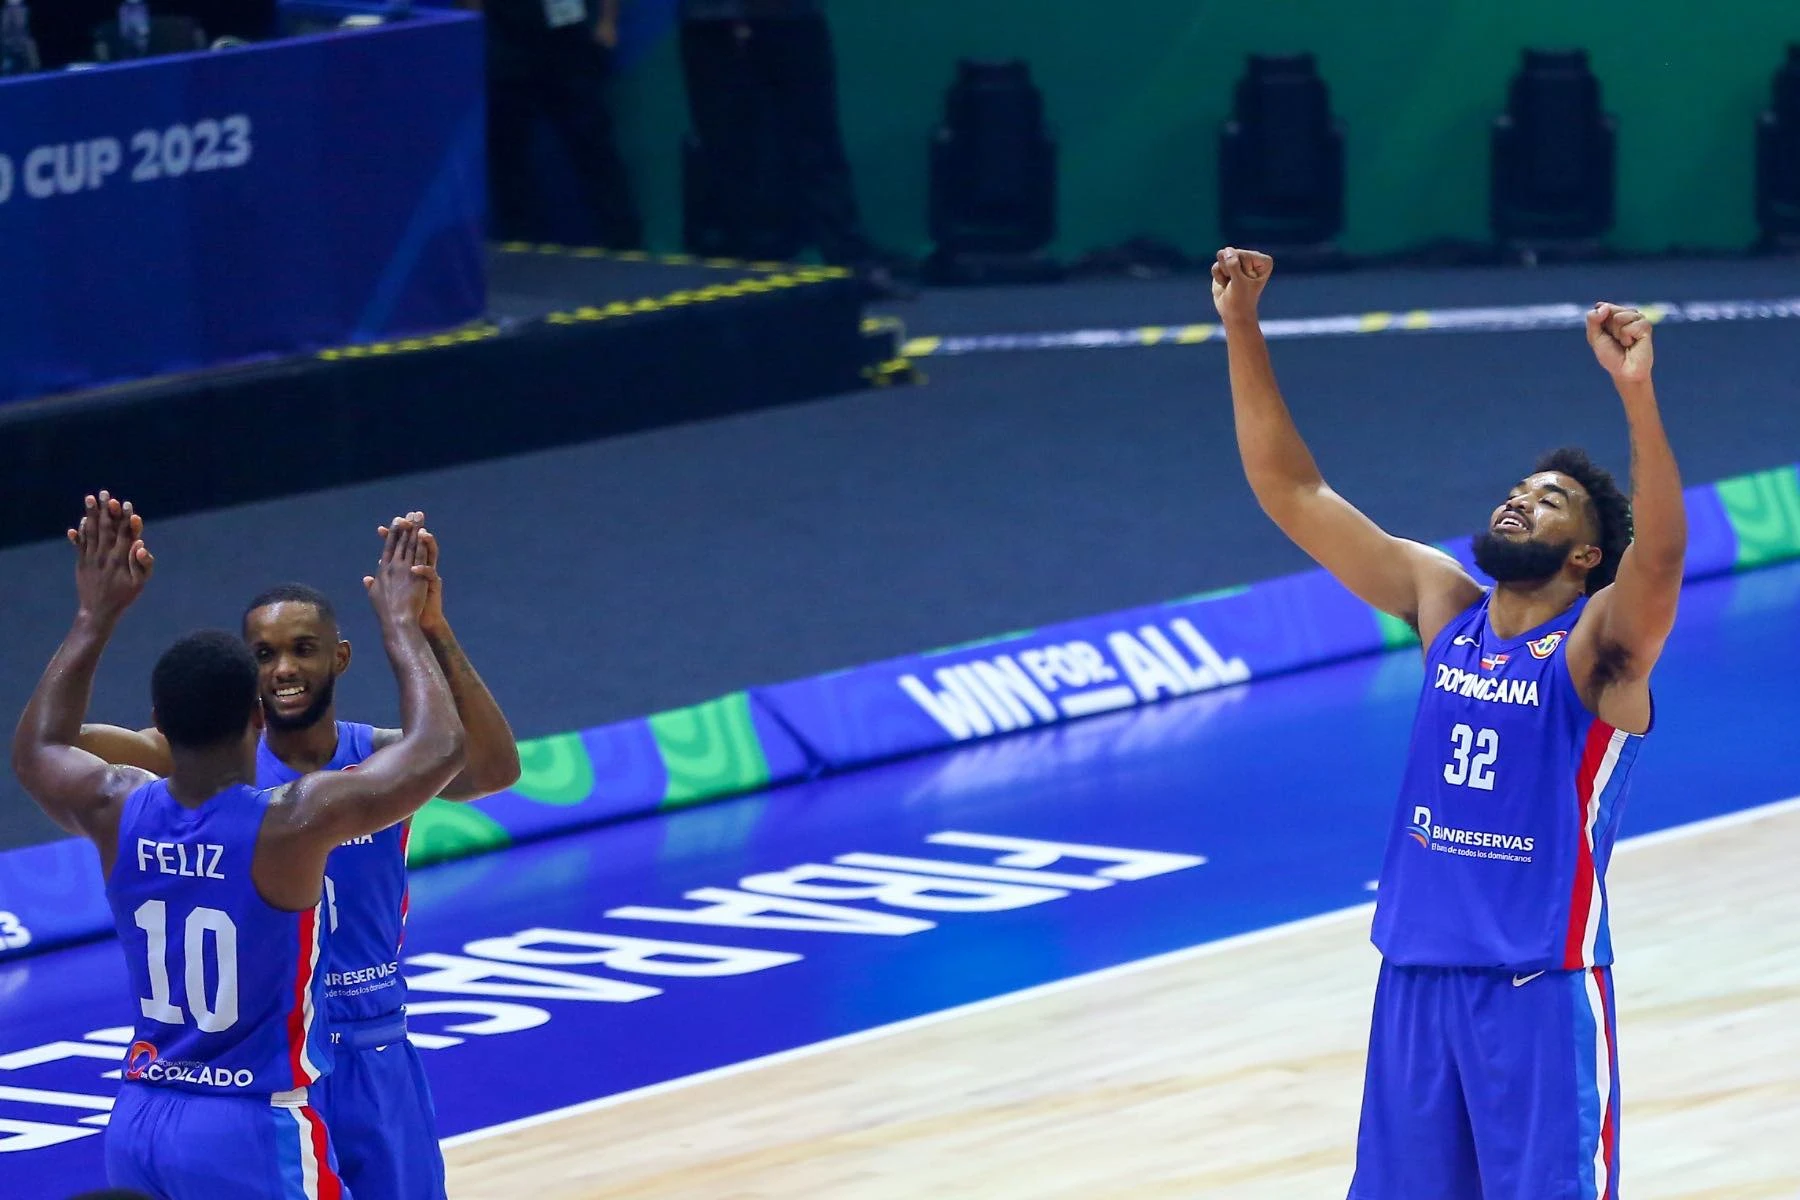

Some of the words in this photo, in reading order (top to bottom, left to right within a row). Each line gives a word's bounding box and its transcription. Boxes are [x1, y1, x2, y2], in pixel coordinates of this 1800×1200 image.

[23, 138, 122, 199] CUP
[130, 114, 252, 183] 2023
[898, 654, 1058, 741] WIN
[1018, 640, 1119, 692] FOR
[1105, 617, 1252, 703] ALL
[1434, 663, 1540, 707] DOMINICANA
[1443, 723, 1499, 791] 32
[136, 837, 226, 880] FELIZ
[1447, 846, 1457, 854] de
[1457, 848, 1477, 857] todos
[1477, 850, 1487, 858] los
[1487, 851, 1532, 863] dominicanos
[605, 830, 1208, 936] FIBA
[133, 899, 238, 1033] 10
[359, 986, 369, 994] los
[147, 1064, 254, 1087] COLLADO
